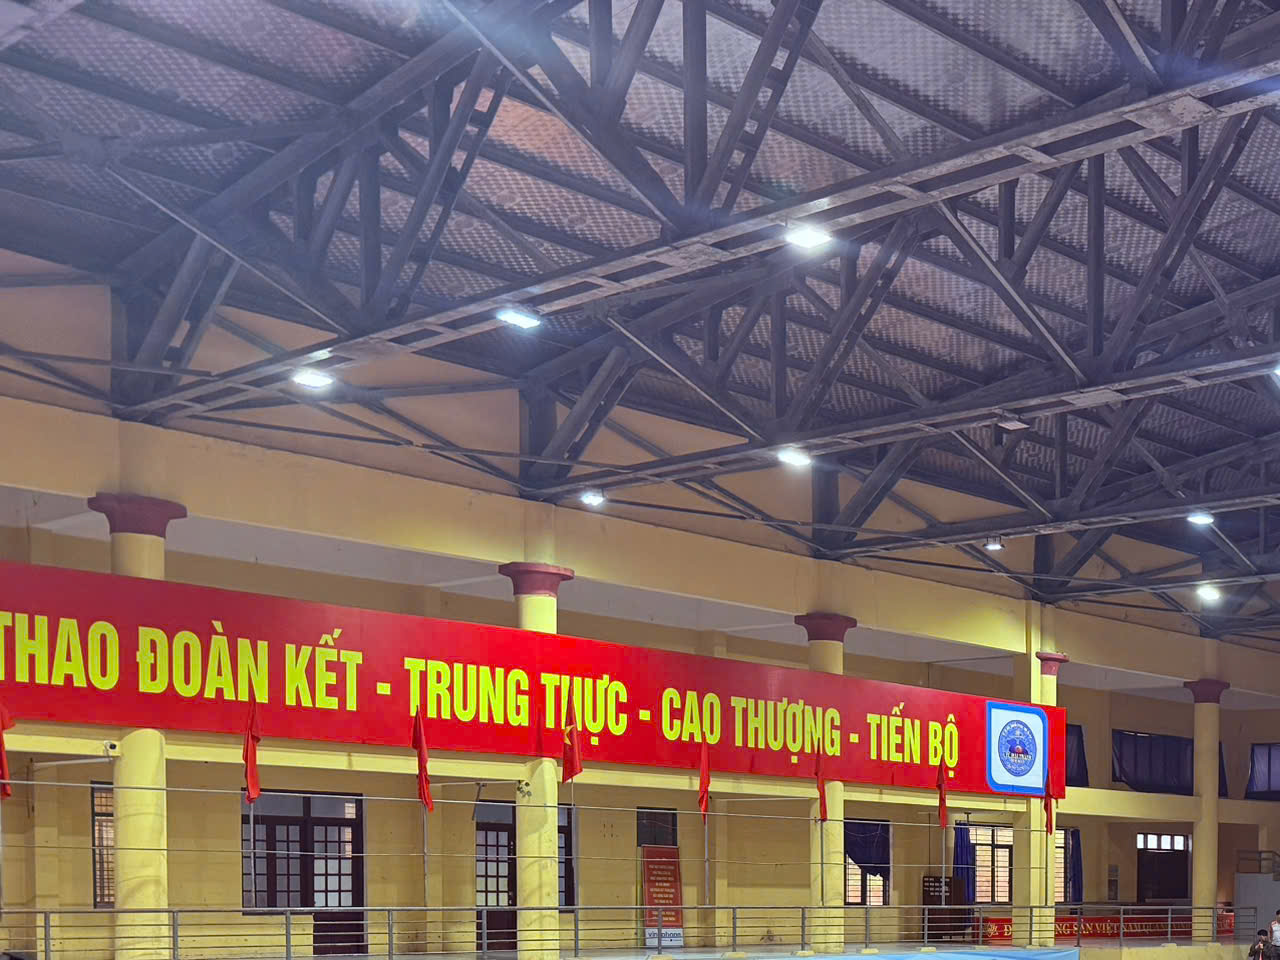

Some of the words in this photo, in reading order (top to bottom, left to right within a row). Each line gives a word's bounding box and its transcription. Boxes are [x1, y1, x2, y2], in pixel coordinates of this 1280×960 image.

[136, 621, 268, 703] ĐOÀN
[286, 629, 362, 711] KẾT
[404, 657, 528, 727] TRUNG
[541, 672, 627, 746] THỰC
[662, 688, 721, 744] CAO
[731, 696, 841, 763] THƯỢNG
[867, 702, 921, 764] TIẾN
[928, 714, 959, 777] BỘ
